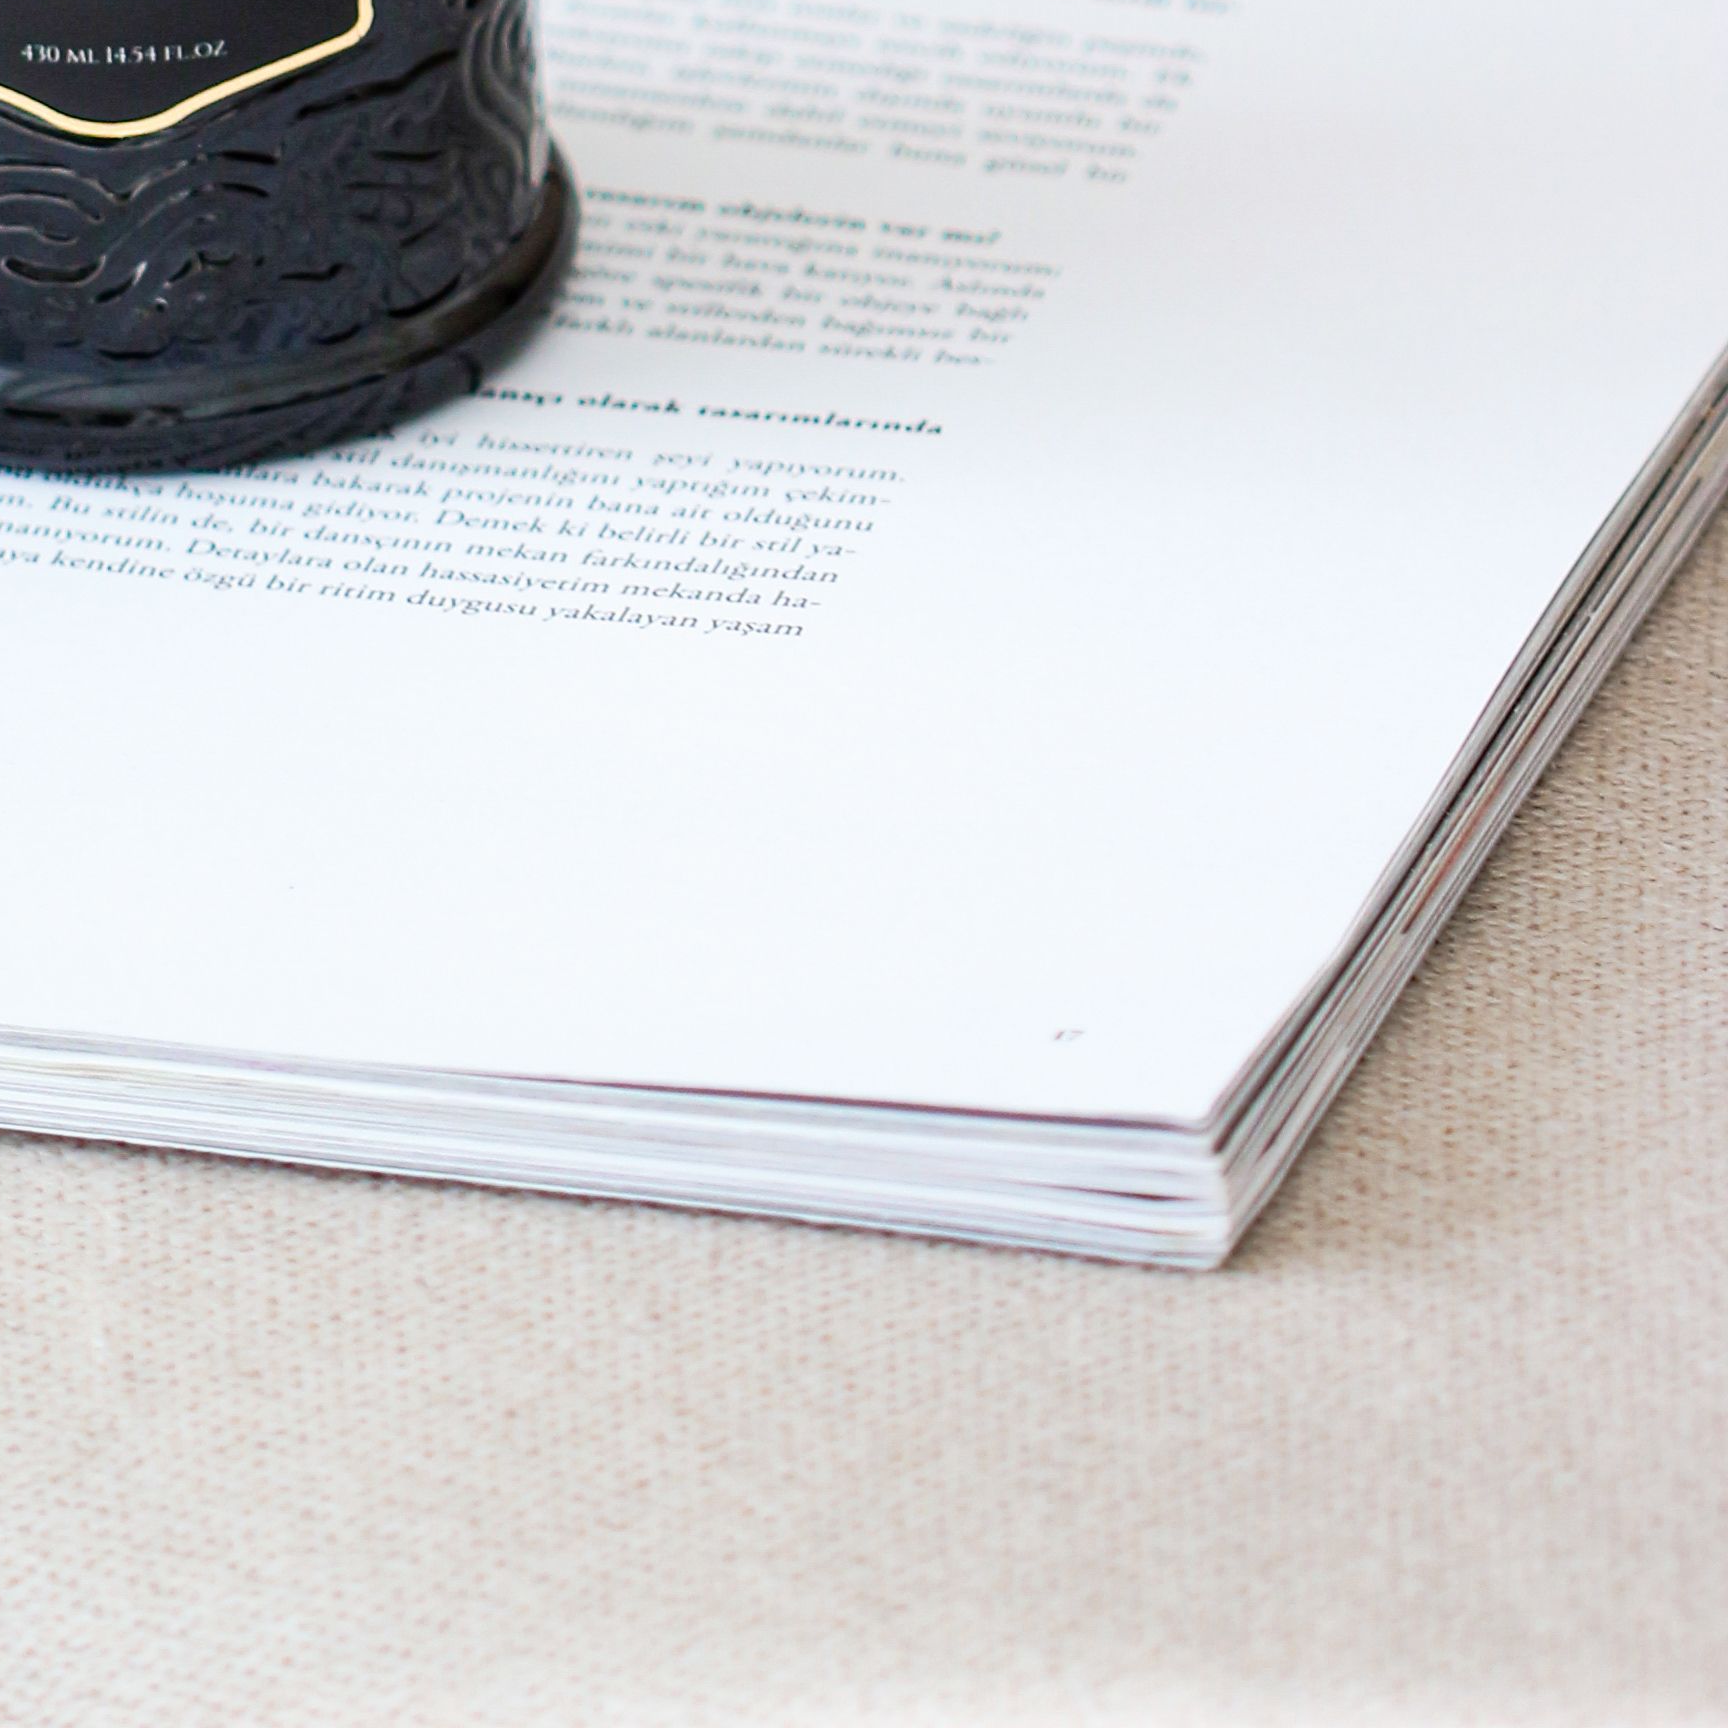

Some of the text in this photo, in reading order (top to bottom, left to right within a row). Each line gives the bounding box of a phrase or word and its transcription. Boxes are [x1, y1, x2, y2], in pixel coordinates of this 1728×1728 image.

[21, 44, 61, 64] 430
[66, 48, 100, 65] ML
[576, 394, 681, 416] olarak
[331, 443, 382, 466] stil
[174, 481, 295, 512] hoşuma
[302, 500, 419, 524] gidiyor.
[435, 510, 544, 534] Demek
[558, 520, 589, 539] ki
[598, 523, 691, 546] belirli
[700, 531, 745, 550] bir
[753, 538, 803, 554] stil
[805, 544, 857, 560] ya-
[310, 469, 429, 497] bakarak
[437, 486, 575, 511] projenin
[587, 495, 660, 517] bana
[672, 505, 713, 521] ait
[724, 508, 875, 533] olduğunu
[51, 497, 91, 516] Bu
[102, 505, 180, 526] stilin
[191, 514, 235, 535] de,
[250, 518, 294, 539] bir
[304, 526, 453, 553] dansçının
[466, 544, 569, 564] mekan
[582, 550, 839, 584] farkındalığından
[186, 539, 333, 570] Detaylara
[343, 557, 409, 577] olan
[420, 562, 610, 595] hassasiyetim
[622, 583, 762, 605] mekanda
[772, 591, 821, 609] ha-
[51, 550, 176, 580] kendine
[184, 569, 257, 591] özgü
[267, 575, 312, 594] bir
[320, 583, 397, 603] ritim
[407, 590, 538, 617] duygusu
[541, 603, 699, 631] yakalayan
[703, 618, 805, 641] yaşam
